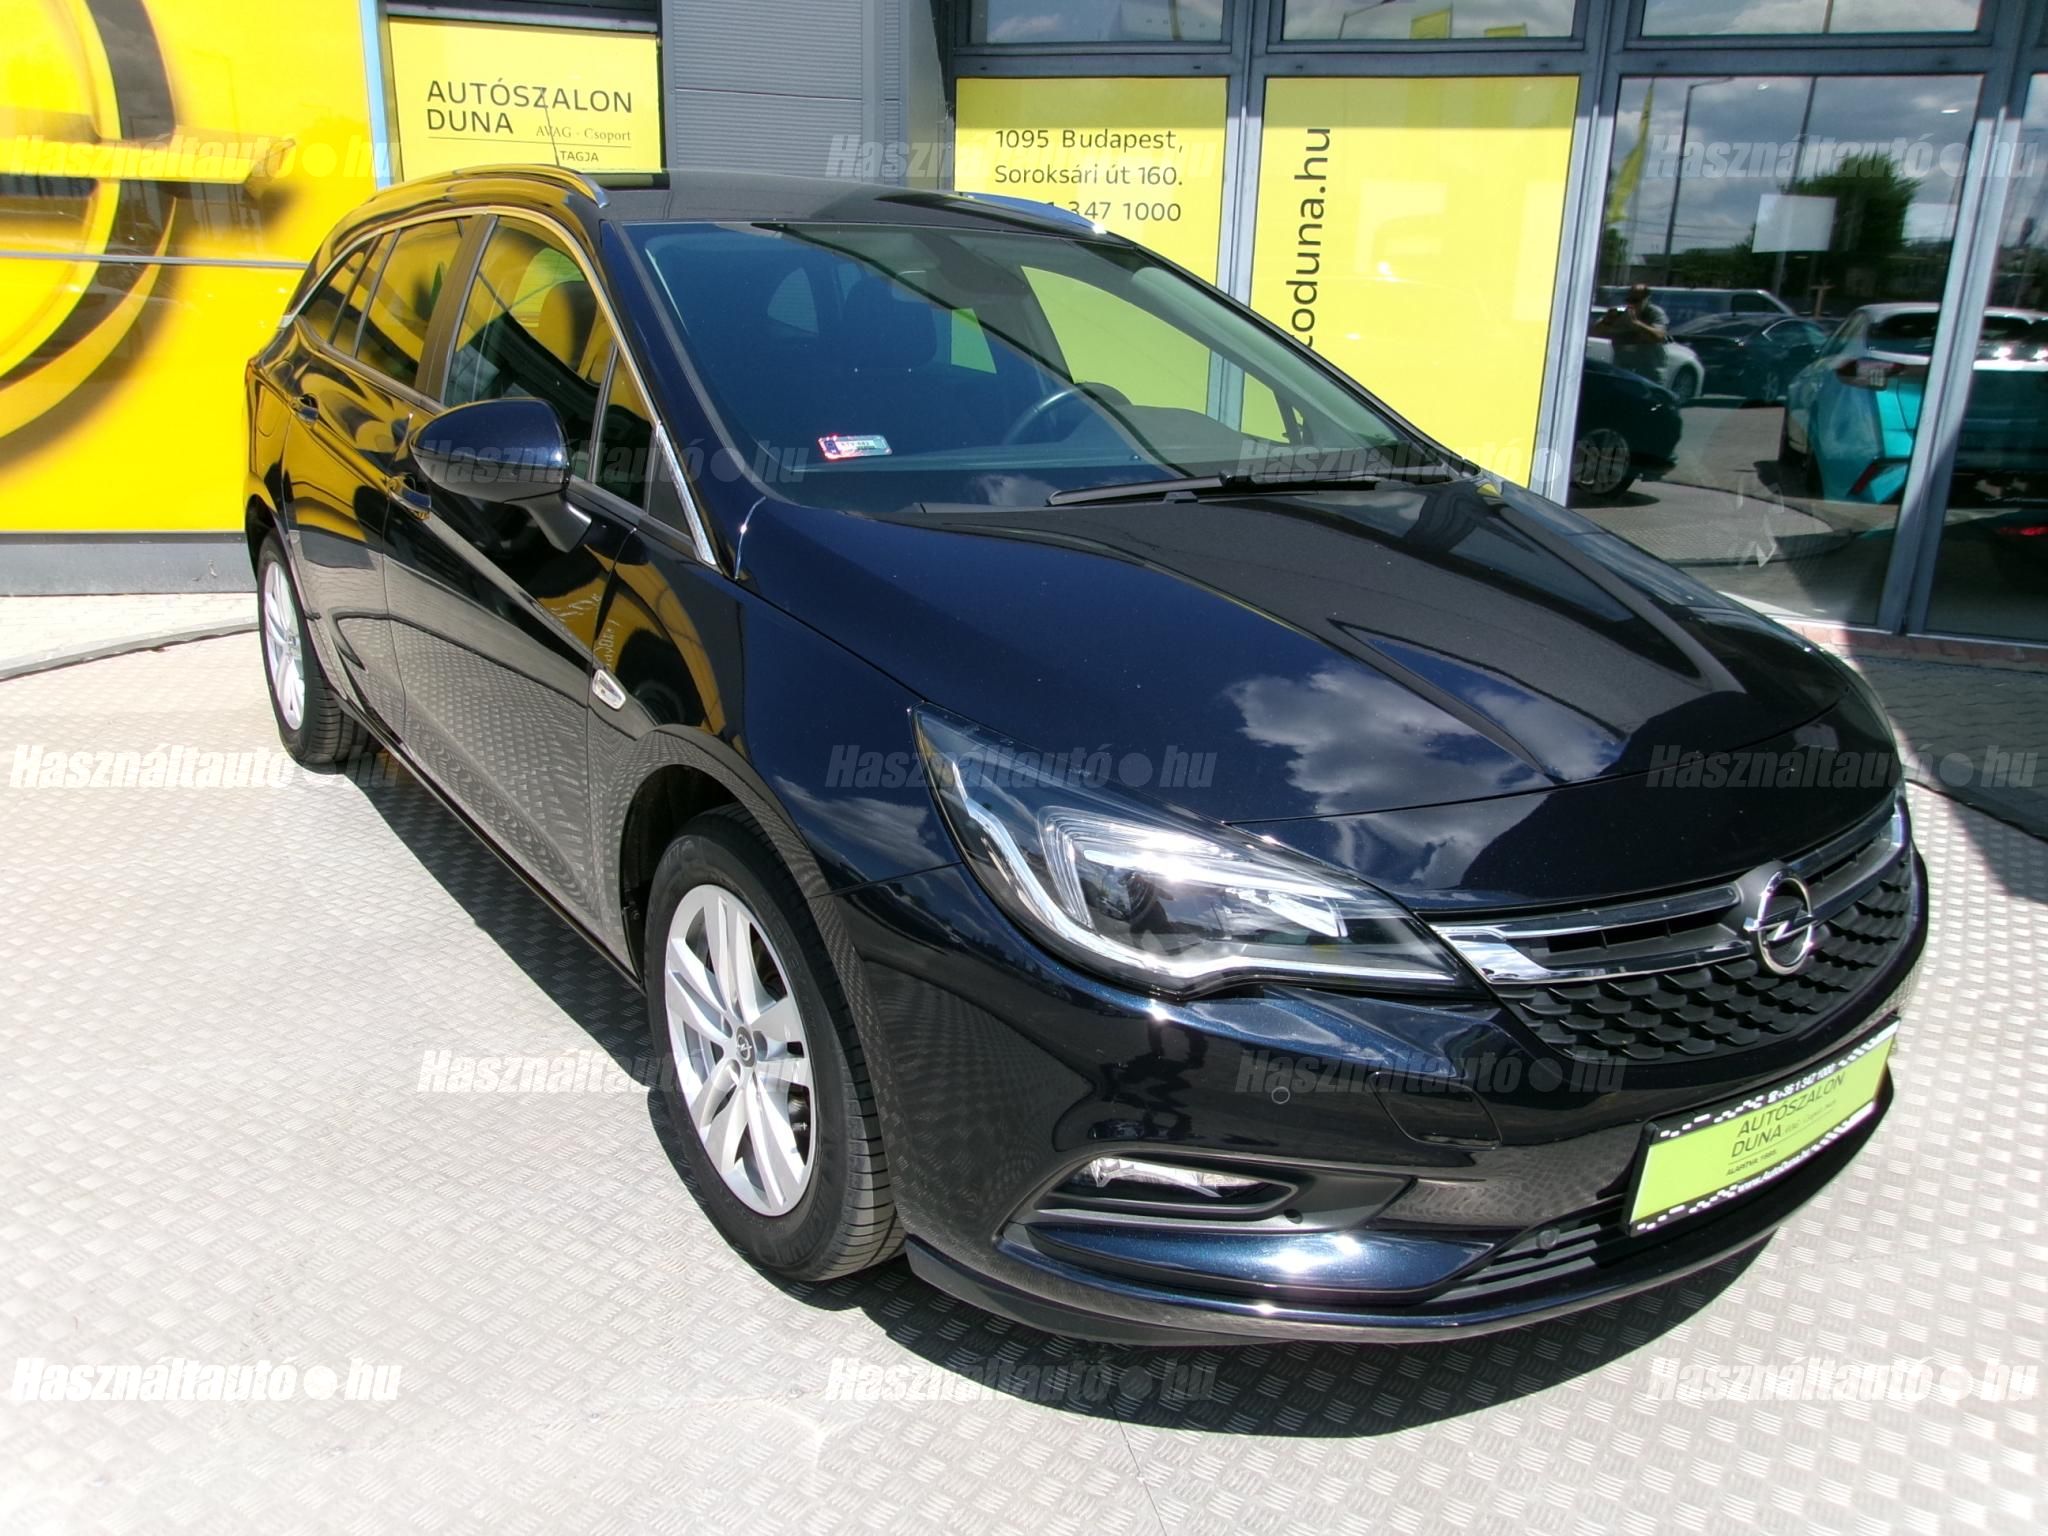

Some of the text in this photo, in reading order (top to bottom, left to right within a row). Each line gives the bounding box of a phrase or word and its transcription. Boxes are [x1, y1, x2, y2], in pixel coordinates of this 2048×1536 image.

[427, 78, 632, 114] AUTÓSZALON
[427, 109, 514, 134] DUNA
[584, 127, 631, 143] Csoport
[995, 128, 1183, 153] 1095 Budapest,
[560, 150, 599, 162] TAGJA
[994, 164, 1183, 186] Soroksári út 160.
[1122, 202, 1182, 221] 1000
[1738, 1071, 1846, 1137] AUTÓSZALON
[1732, 1124, 1781, 1157] DUNA
